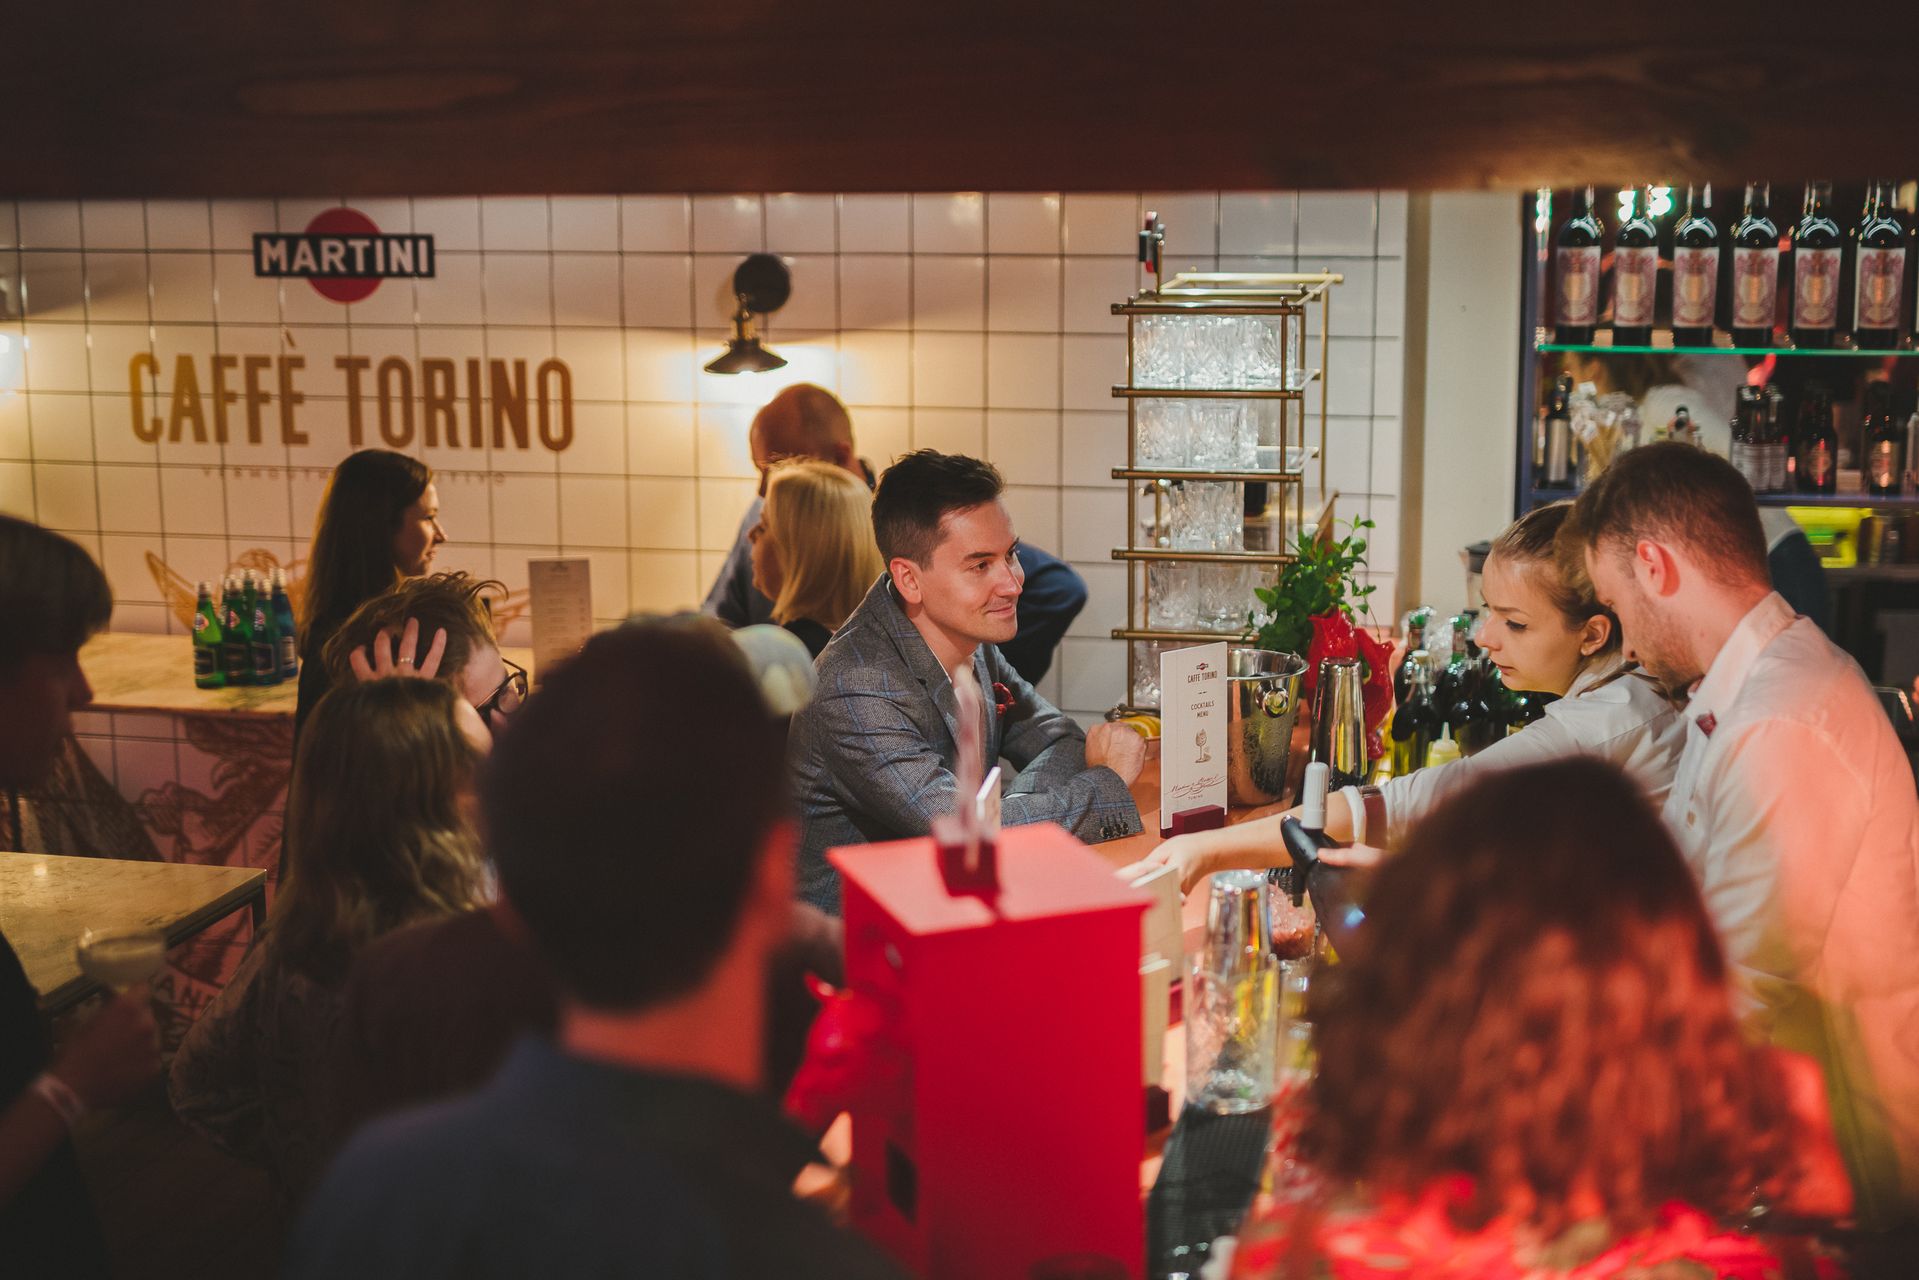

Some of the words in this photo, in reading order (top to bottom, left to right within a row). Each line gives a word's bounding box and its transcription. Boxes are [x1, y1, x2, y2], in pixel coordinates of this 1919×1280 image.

[260, 238, 429, 273] MARTINI
[129, 326, 310, 445] CAFFÈ
[334, 356, 574, 452] TORINO
[1191, 700, 1215, 711] COCKTAILS
